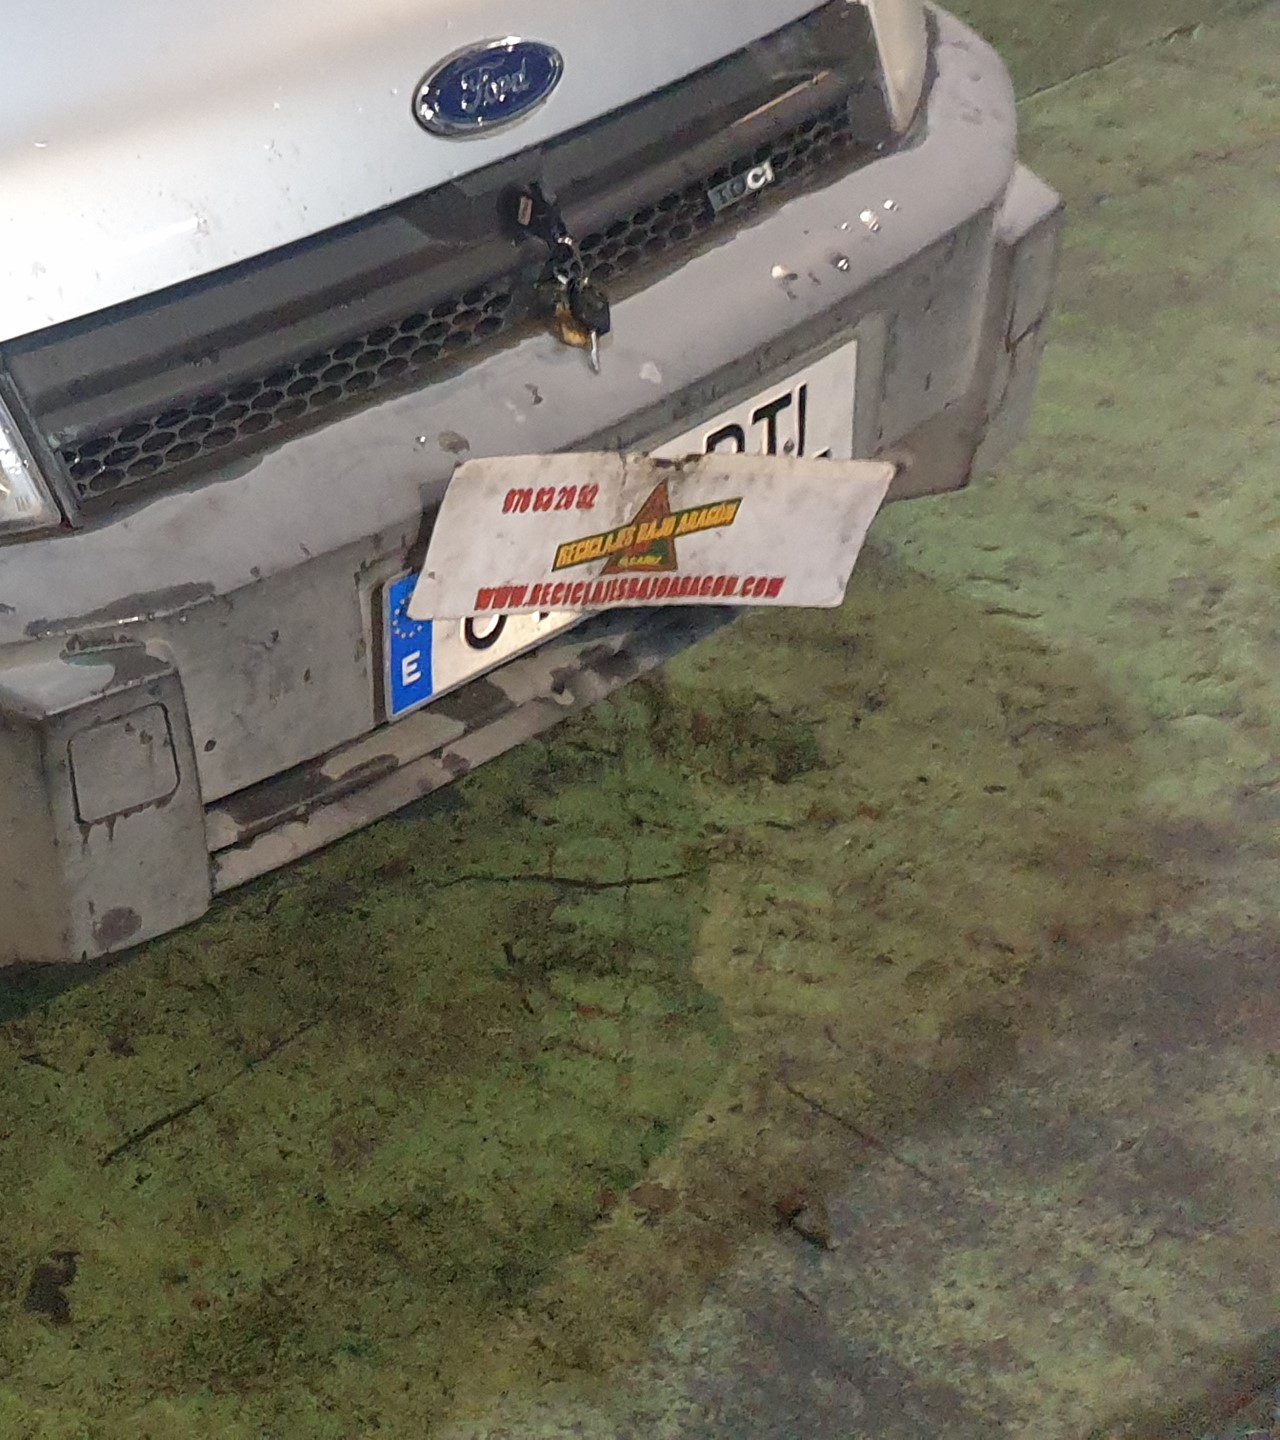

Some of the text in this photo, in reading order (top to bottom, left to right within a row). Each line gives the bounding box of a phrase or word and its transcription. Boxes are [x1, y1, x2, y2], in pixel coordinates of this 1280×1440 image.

[461, 57, 531, 113] Ford
[556, 526, 636, 566] RECICLAJES
[637, 515, 676, 543] BAJO
[402, 650, 422, 686] E
